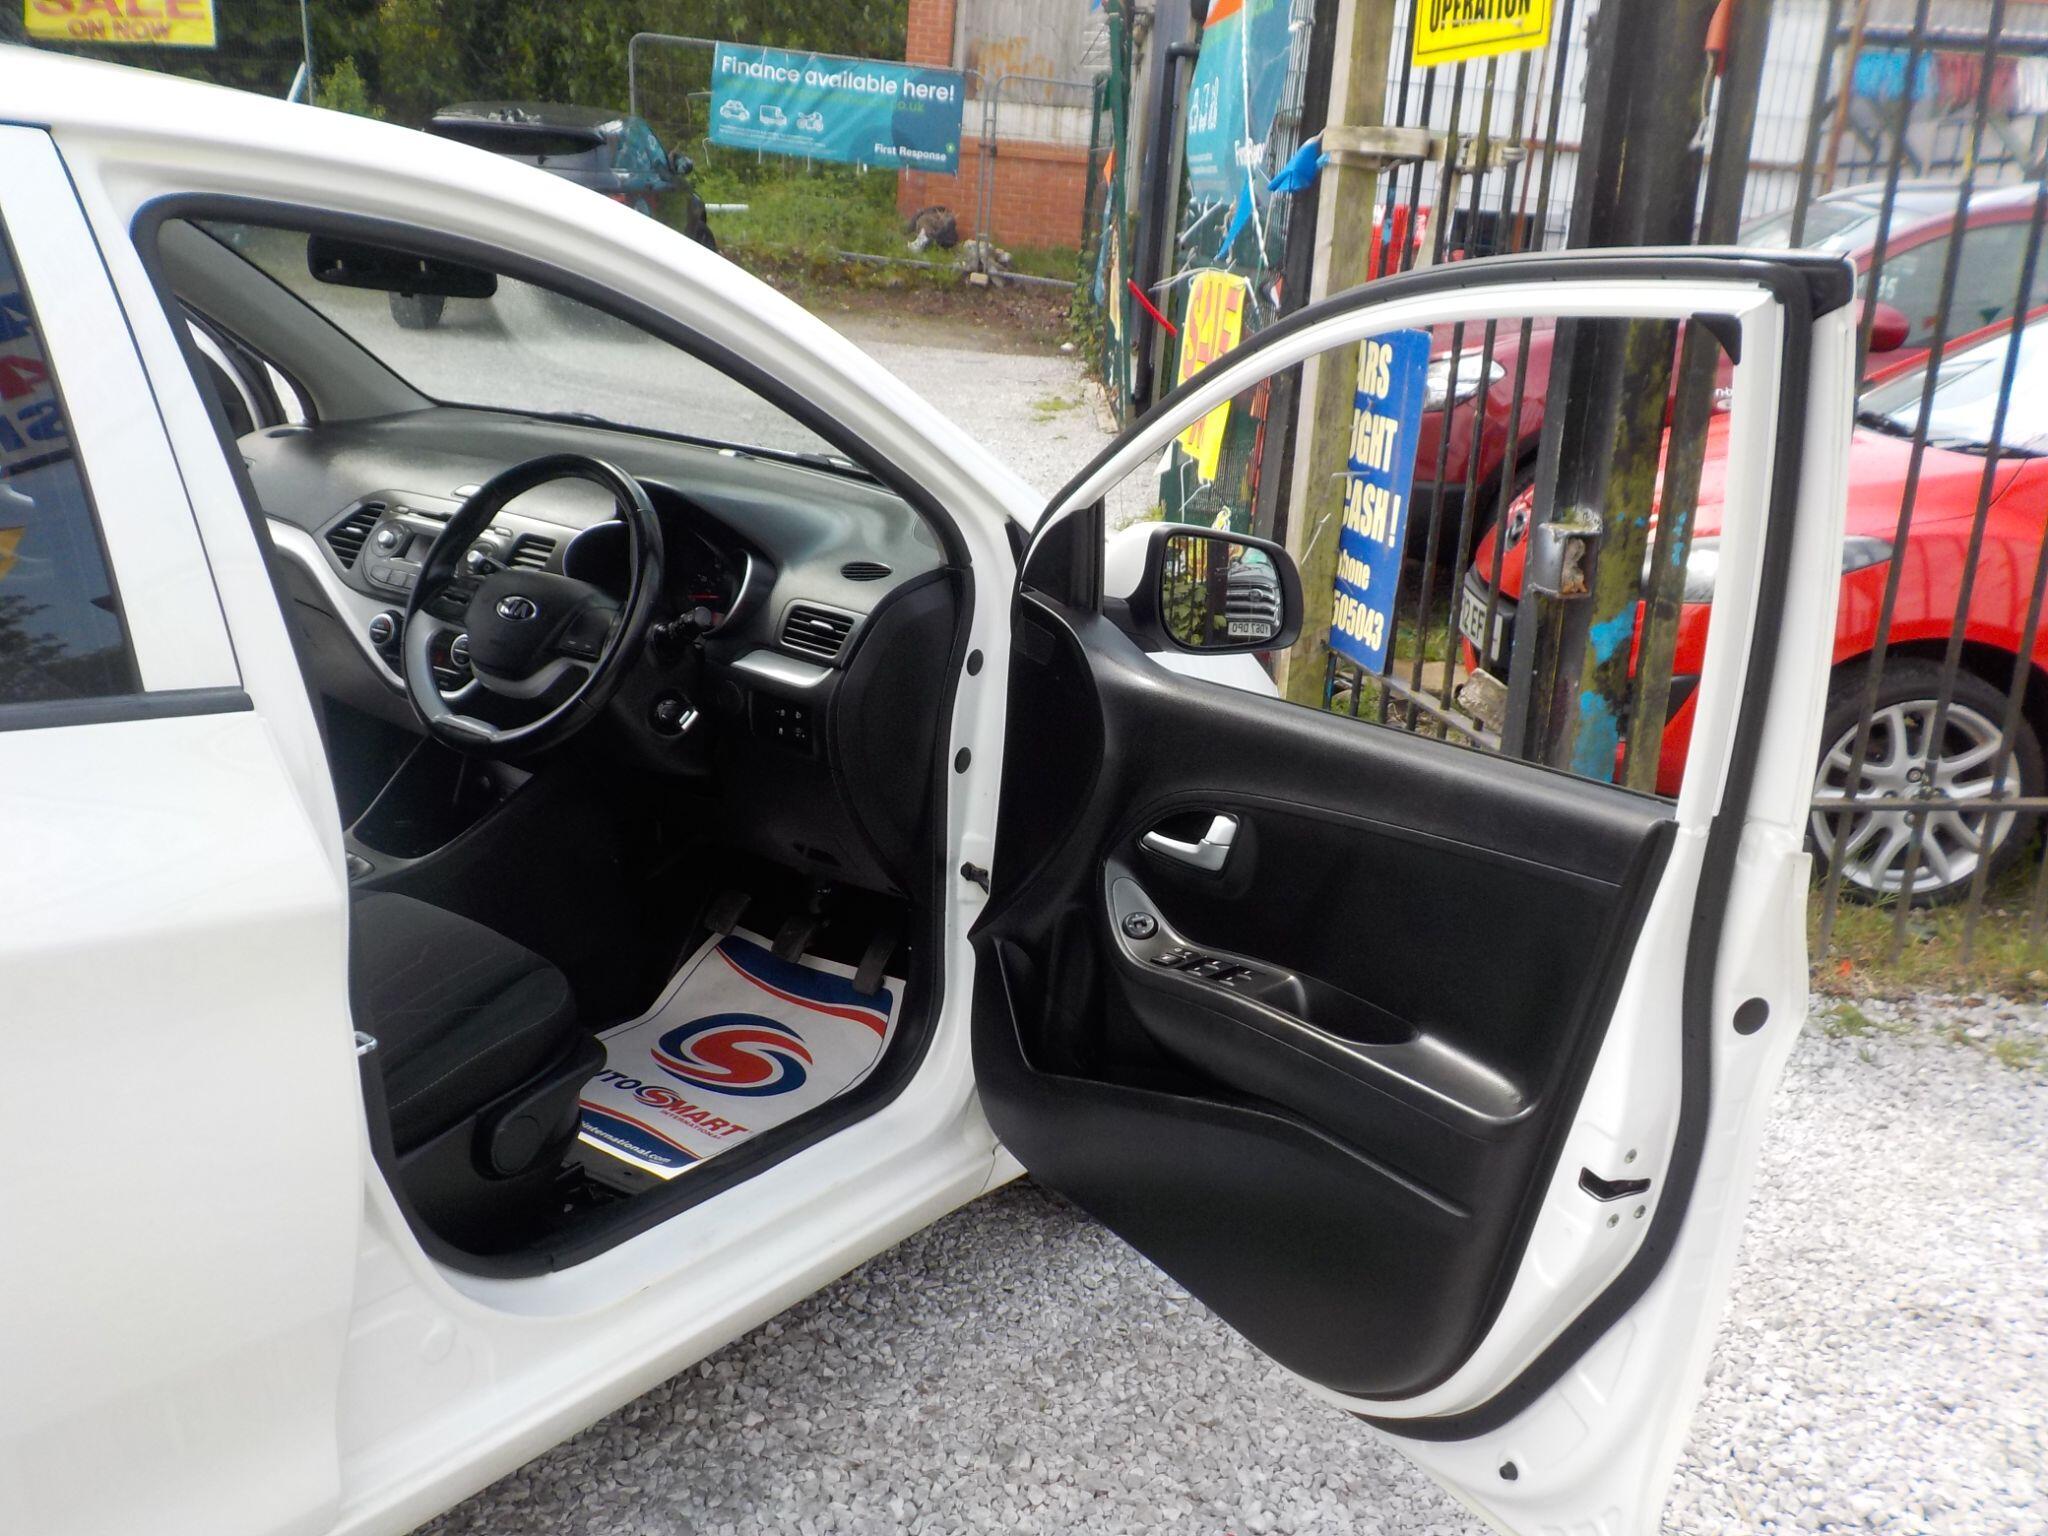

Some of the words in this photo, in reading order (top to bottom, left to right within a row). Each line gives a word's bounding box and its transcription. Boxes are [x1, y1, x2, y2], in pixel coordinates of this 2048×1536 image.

[67, 18, 106, 39] ON
[112, 19, 172, 41] NOW
[721, 55, 800, 84] Finance
[804, 69, 898, 96] available
[903, 78, 955, 102] here!
[873, 143, 897, 156] First
[899, 145, 947, 161] Response
[595, 1068, 749, 1137] TOSMART
[660, 1109, 722, 1140] INTERNATIONAL
